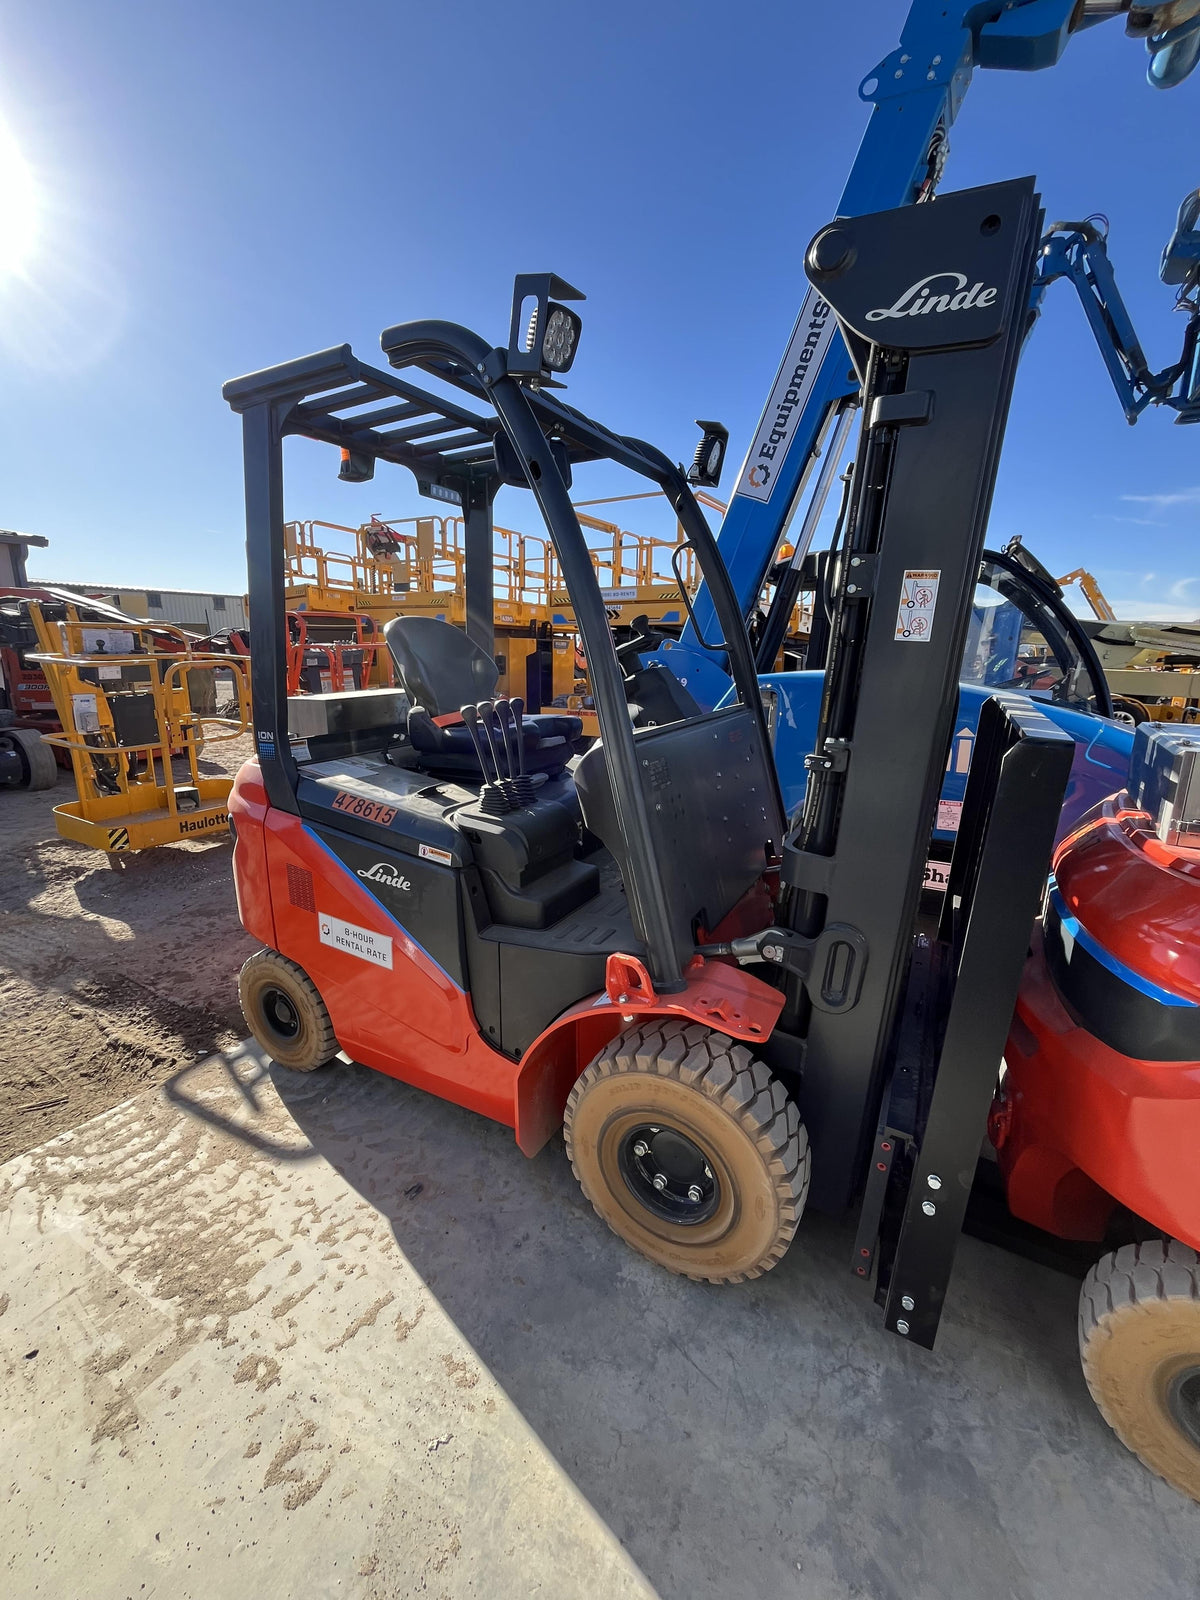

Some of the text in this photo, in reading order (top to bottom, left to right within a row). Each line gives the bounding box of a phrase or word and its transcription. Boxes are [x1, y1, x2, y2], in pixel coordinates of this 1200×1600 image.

[865, 272, 997, 321] Linde
[258, 731, 274, 740] ION
[335, 793, 396, 824] 478615
[357, 863, 411, 891] Linde
[336, 936, 387, 961] RENTAL RATE
[345, 928, 374, 945] 8-HOUR
